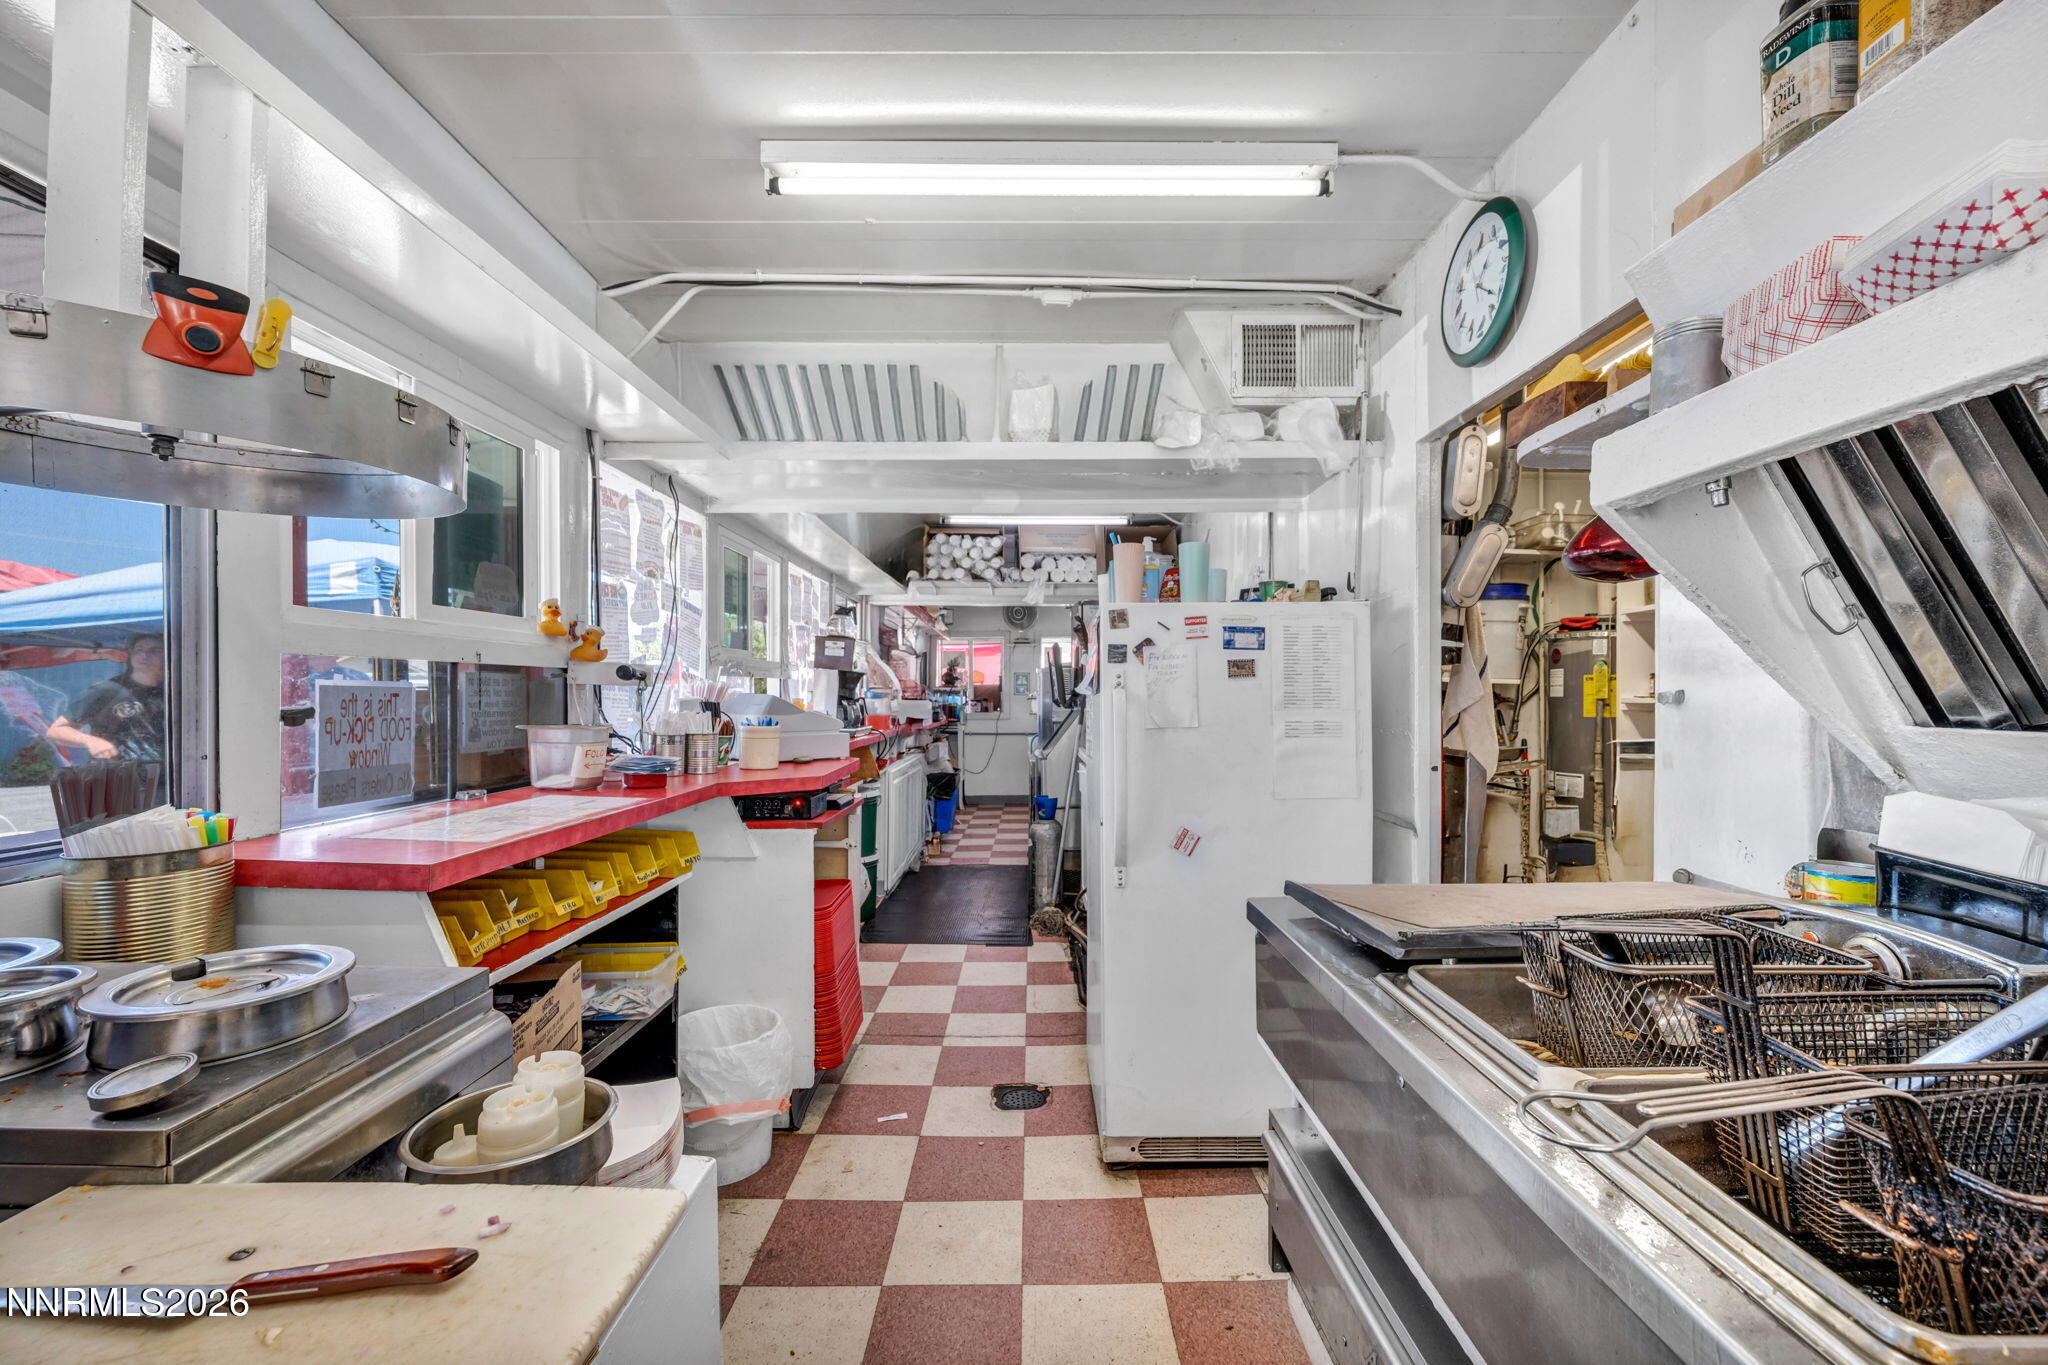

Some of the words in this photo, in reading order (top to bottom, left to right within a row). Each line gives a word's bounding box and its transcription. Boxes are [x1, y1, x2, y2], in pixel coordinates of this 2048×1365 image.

[1775, 46, 1791, 69] D
[1773, 75, 1796, 95] whole
[1773, 84, 1796, 109] Dill
[1770, 93, 1801, 122] Weed
